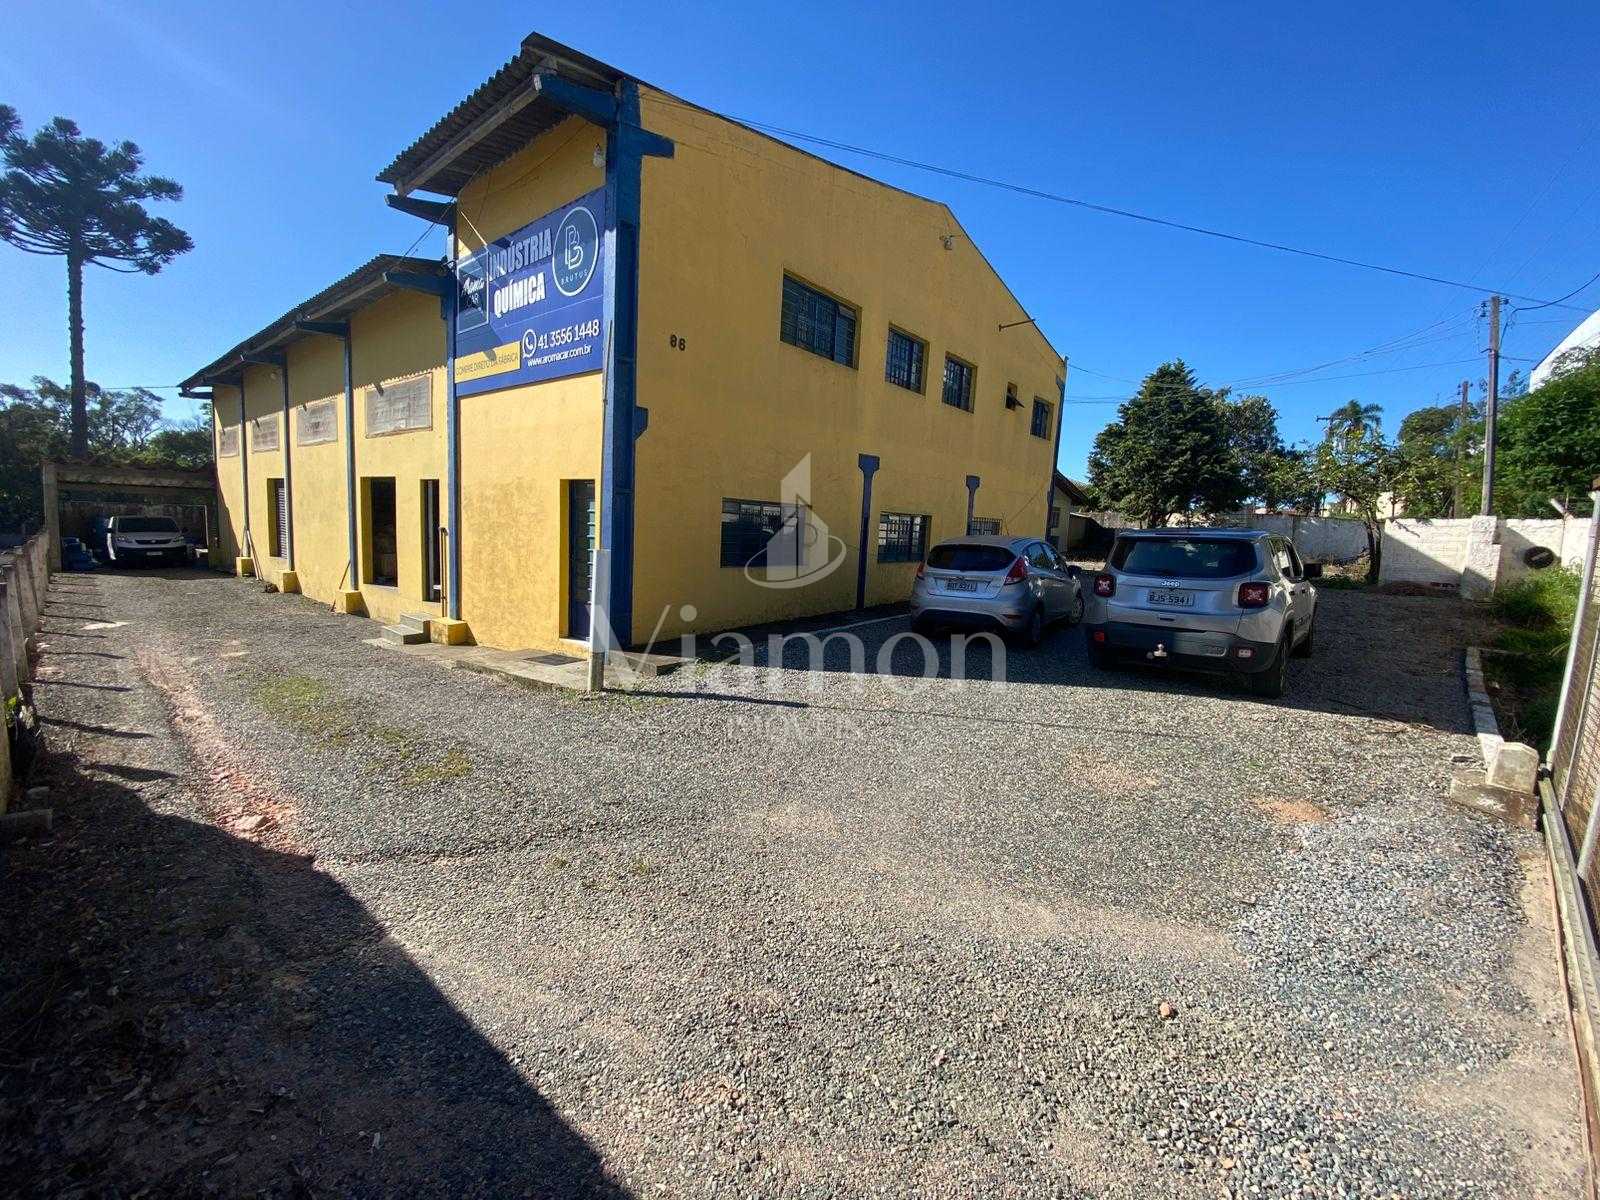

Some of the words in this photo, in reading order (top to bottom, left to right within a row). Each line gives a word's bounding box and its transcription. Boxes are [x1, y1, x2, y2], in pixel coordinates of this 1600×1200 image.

[489, 228, 553, 281] INDÚSTRIA
[494, 271, 546, 318] QUÍMICA
[561, 268, 588, 286] BRUTOS
[537, 333, 549, 350] 41
[549, 326, 573, 348] 3556
[573, 319, 600, 341] 1448
